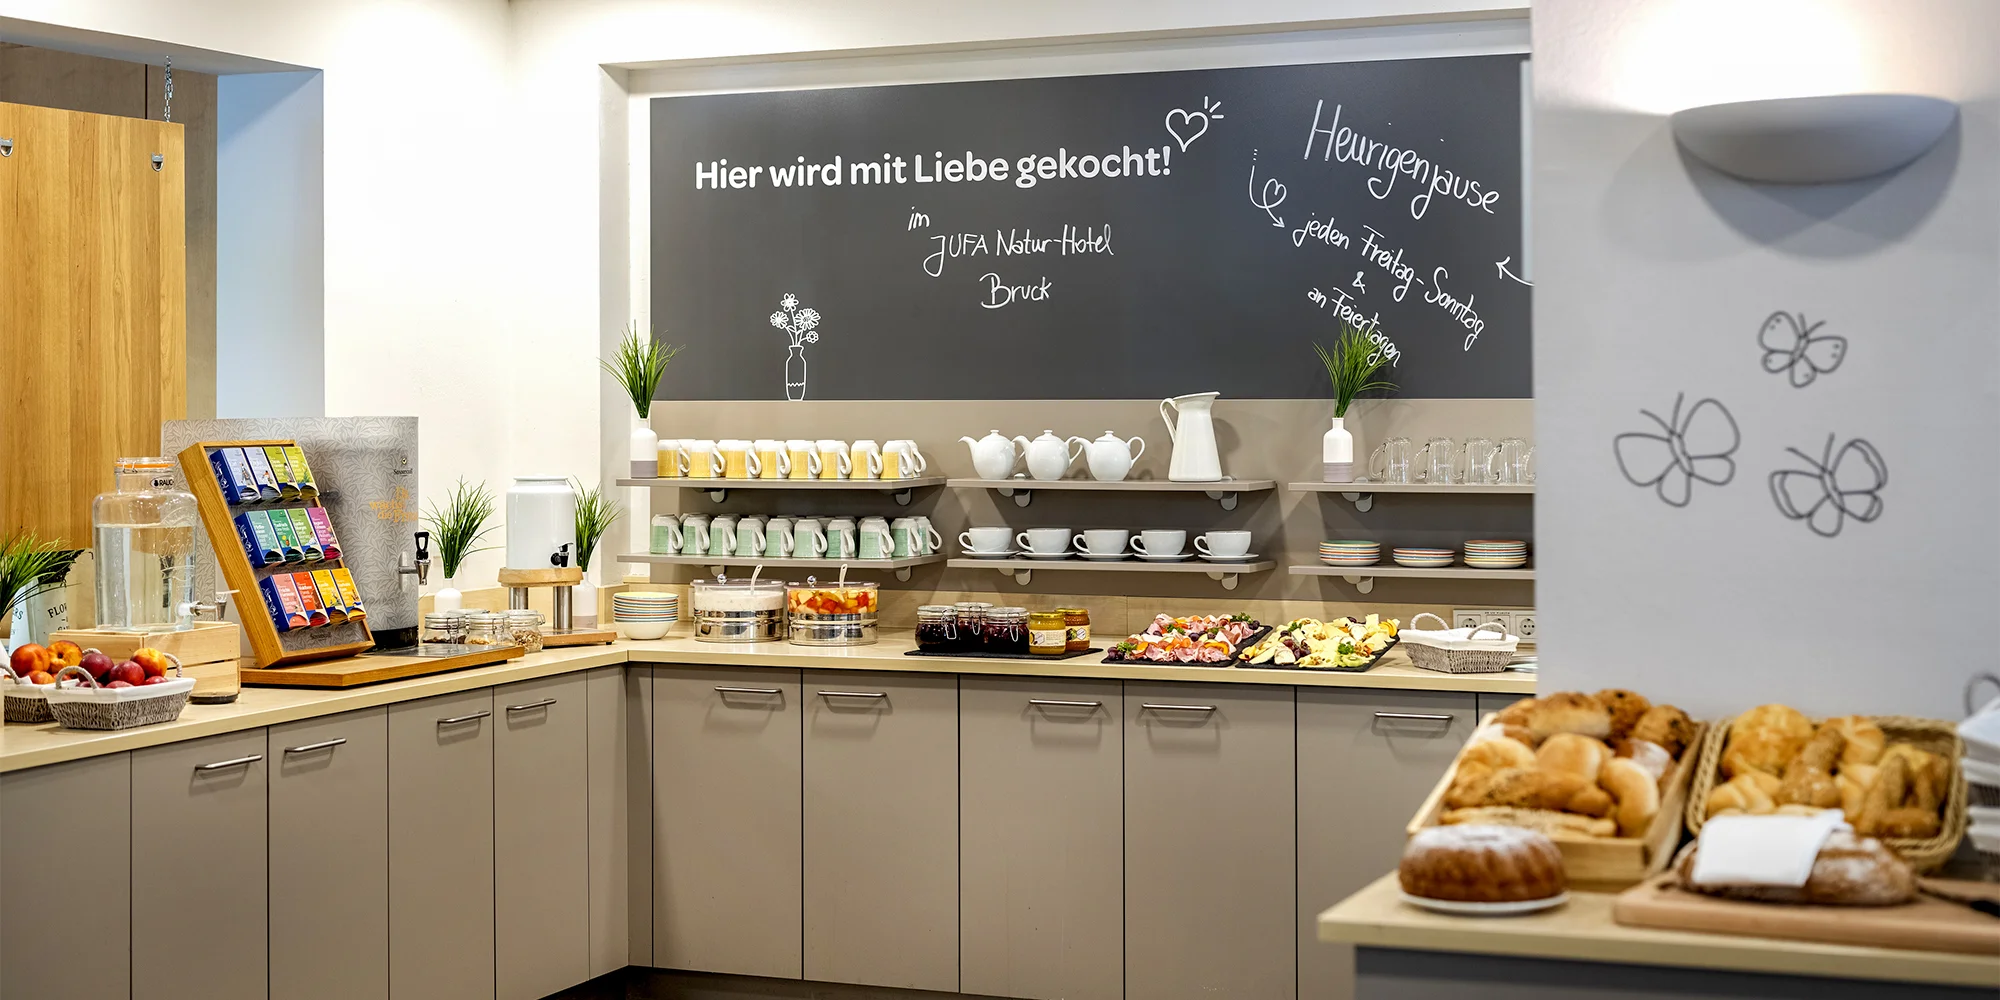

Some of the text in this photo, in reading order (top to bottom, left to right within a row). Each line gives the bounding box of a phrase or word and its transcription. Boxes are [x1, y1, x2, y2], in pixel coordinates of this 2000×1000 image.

[695, 145, 1171, 190] Hier wird mit Liebe gekocht!
[1303, 98, 1500, 221] Heurigenjause
[907, 206, 931, 232] im
[1292, 212, 1350, 250] jeden
[922, 223, 1115, 278] JUFA Natur-Hotel
[978, 272, 1053, 309] Bruck
[1351, 271, 1366, 295] &
[1307, 286, 1401, 369] an Feiertagen
[47, 602, 67, 619] FLO
